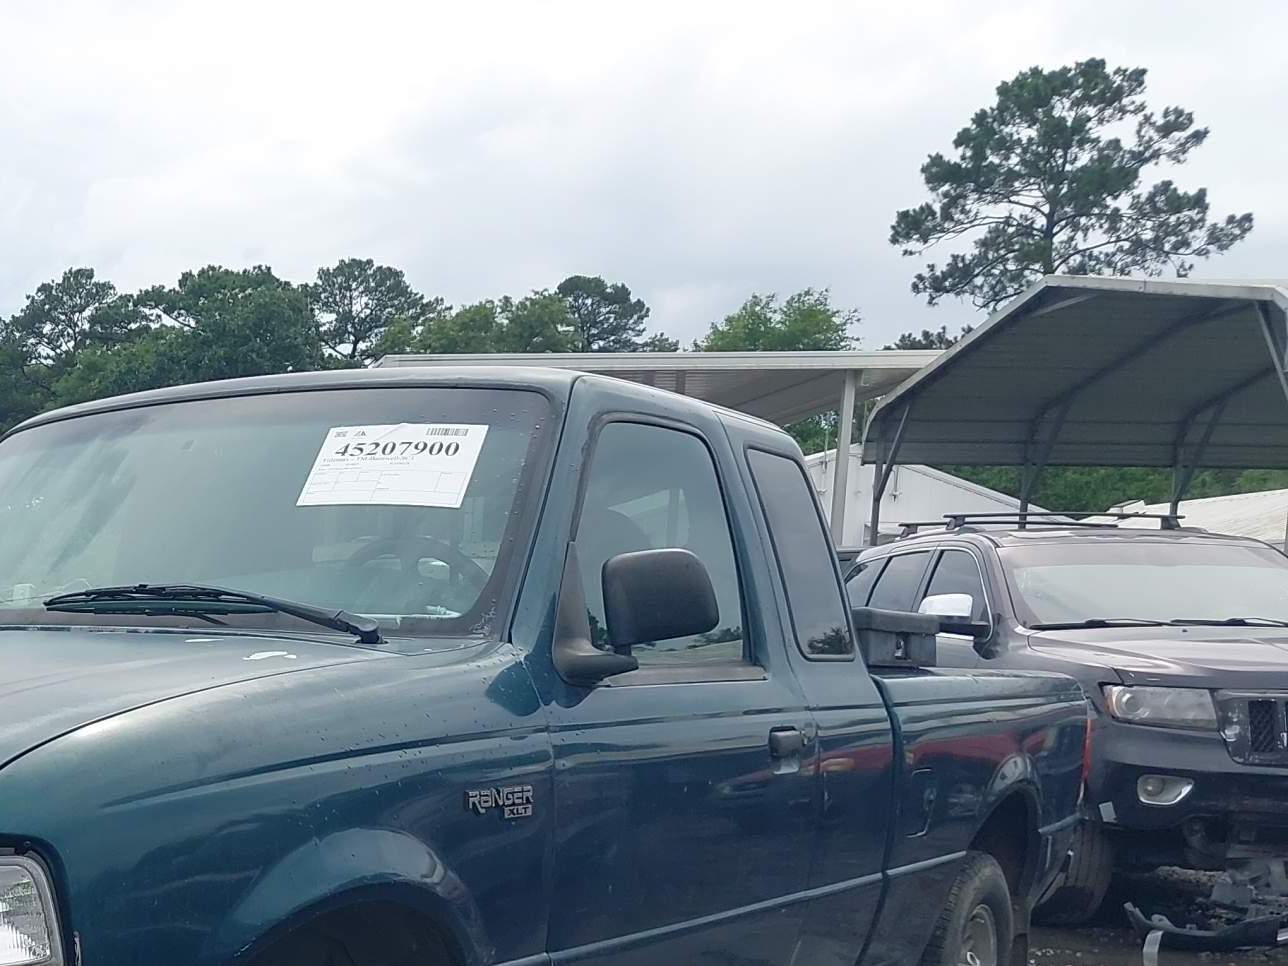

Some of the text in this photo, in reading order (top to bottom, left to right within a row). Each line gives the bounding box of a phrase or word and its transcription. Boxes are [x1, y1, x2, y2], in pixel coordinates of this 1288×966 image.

[334, 441, 461, 458] 45207900
[468, 785, 534, 814] RANGER
[506, 806, 530, 817] XLT
